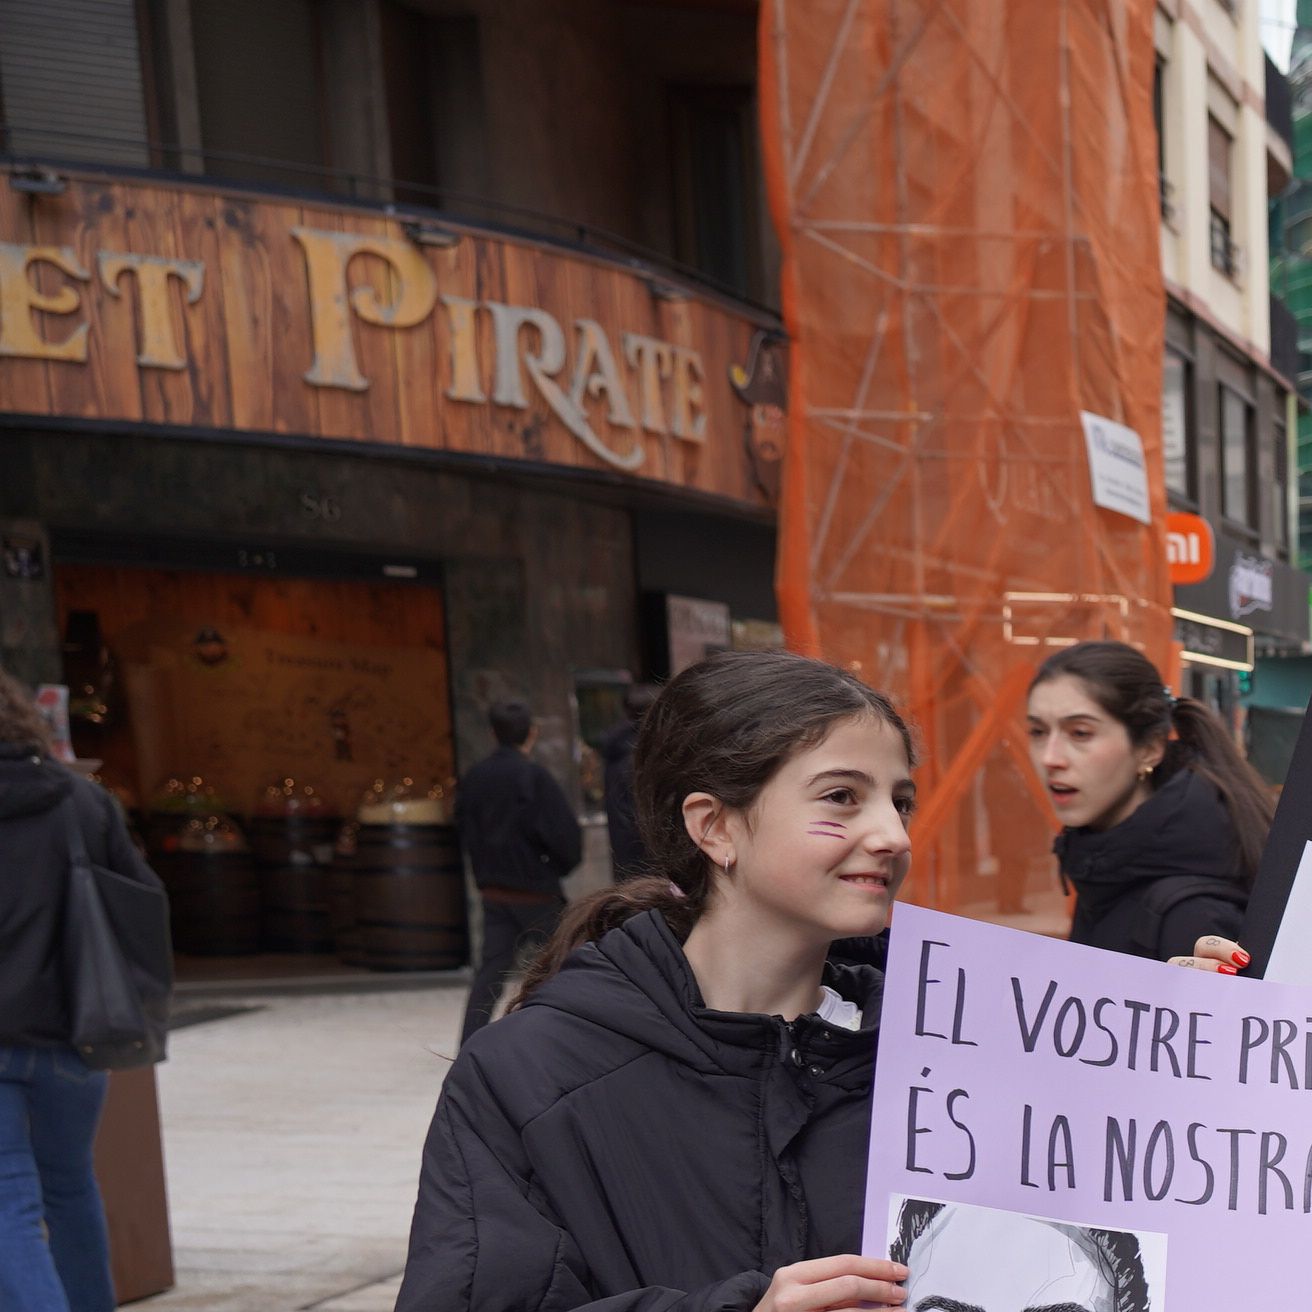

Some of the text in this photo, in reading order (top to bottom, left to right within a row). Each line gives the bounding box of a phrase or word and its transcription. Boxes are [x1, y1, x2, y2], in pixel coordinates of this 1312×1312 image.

[291, 226, 707, 471] PIRATE
[914, 940, 978, 1046] EL
[1010, 977, 1214, 1082] VOSTRE
[905, 1067, 976, 1180] ÉS
[1020, 1104, 1077, 1192] LA
